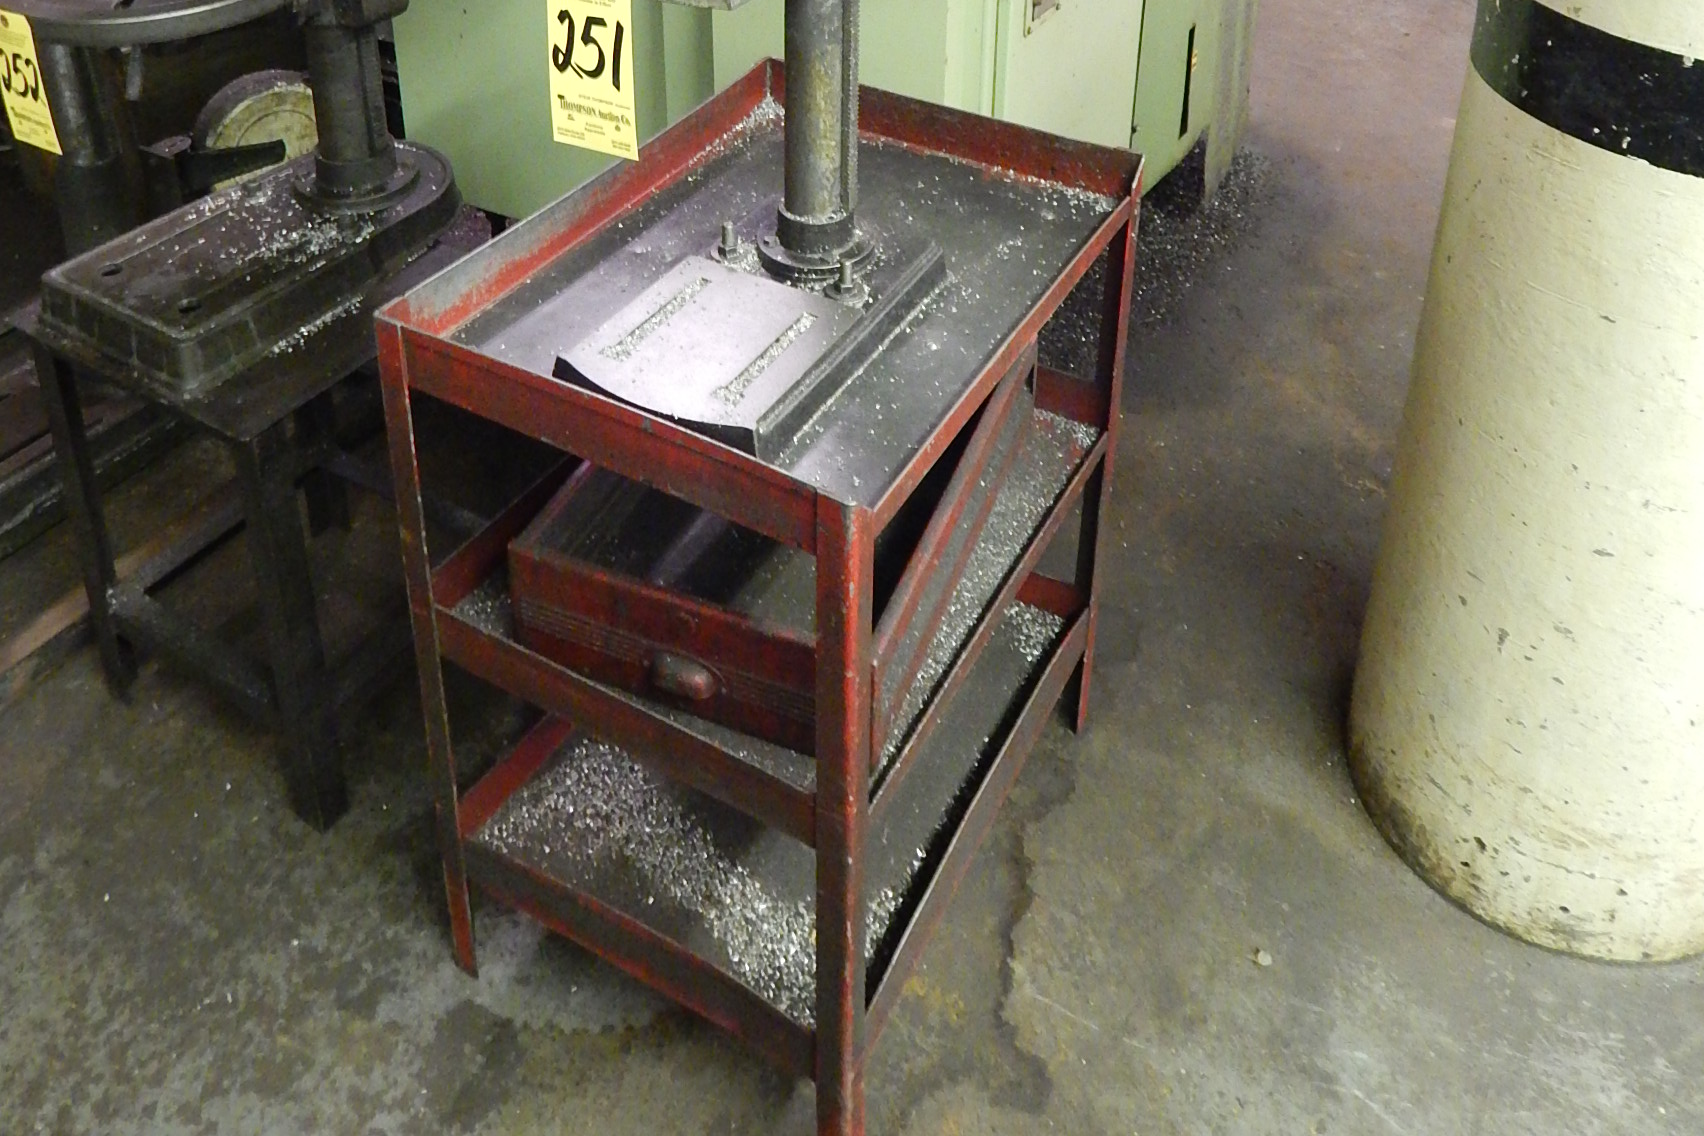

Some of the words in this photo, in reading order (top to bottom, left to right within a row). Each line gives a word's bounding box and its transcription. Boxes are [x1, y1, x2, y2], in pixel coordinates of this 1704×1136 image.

[0, 47, 42, 103] 252
[552, 9, 624, 92] 251
[557, 93, 597, 117] THOMPSON
